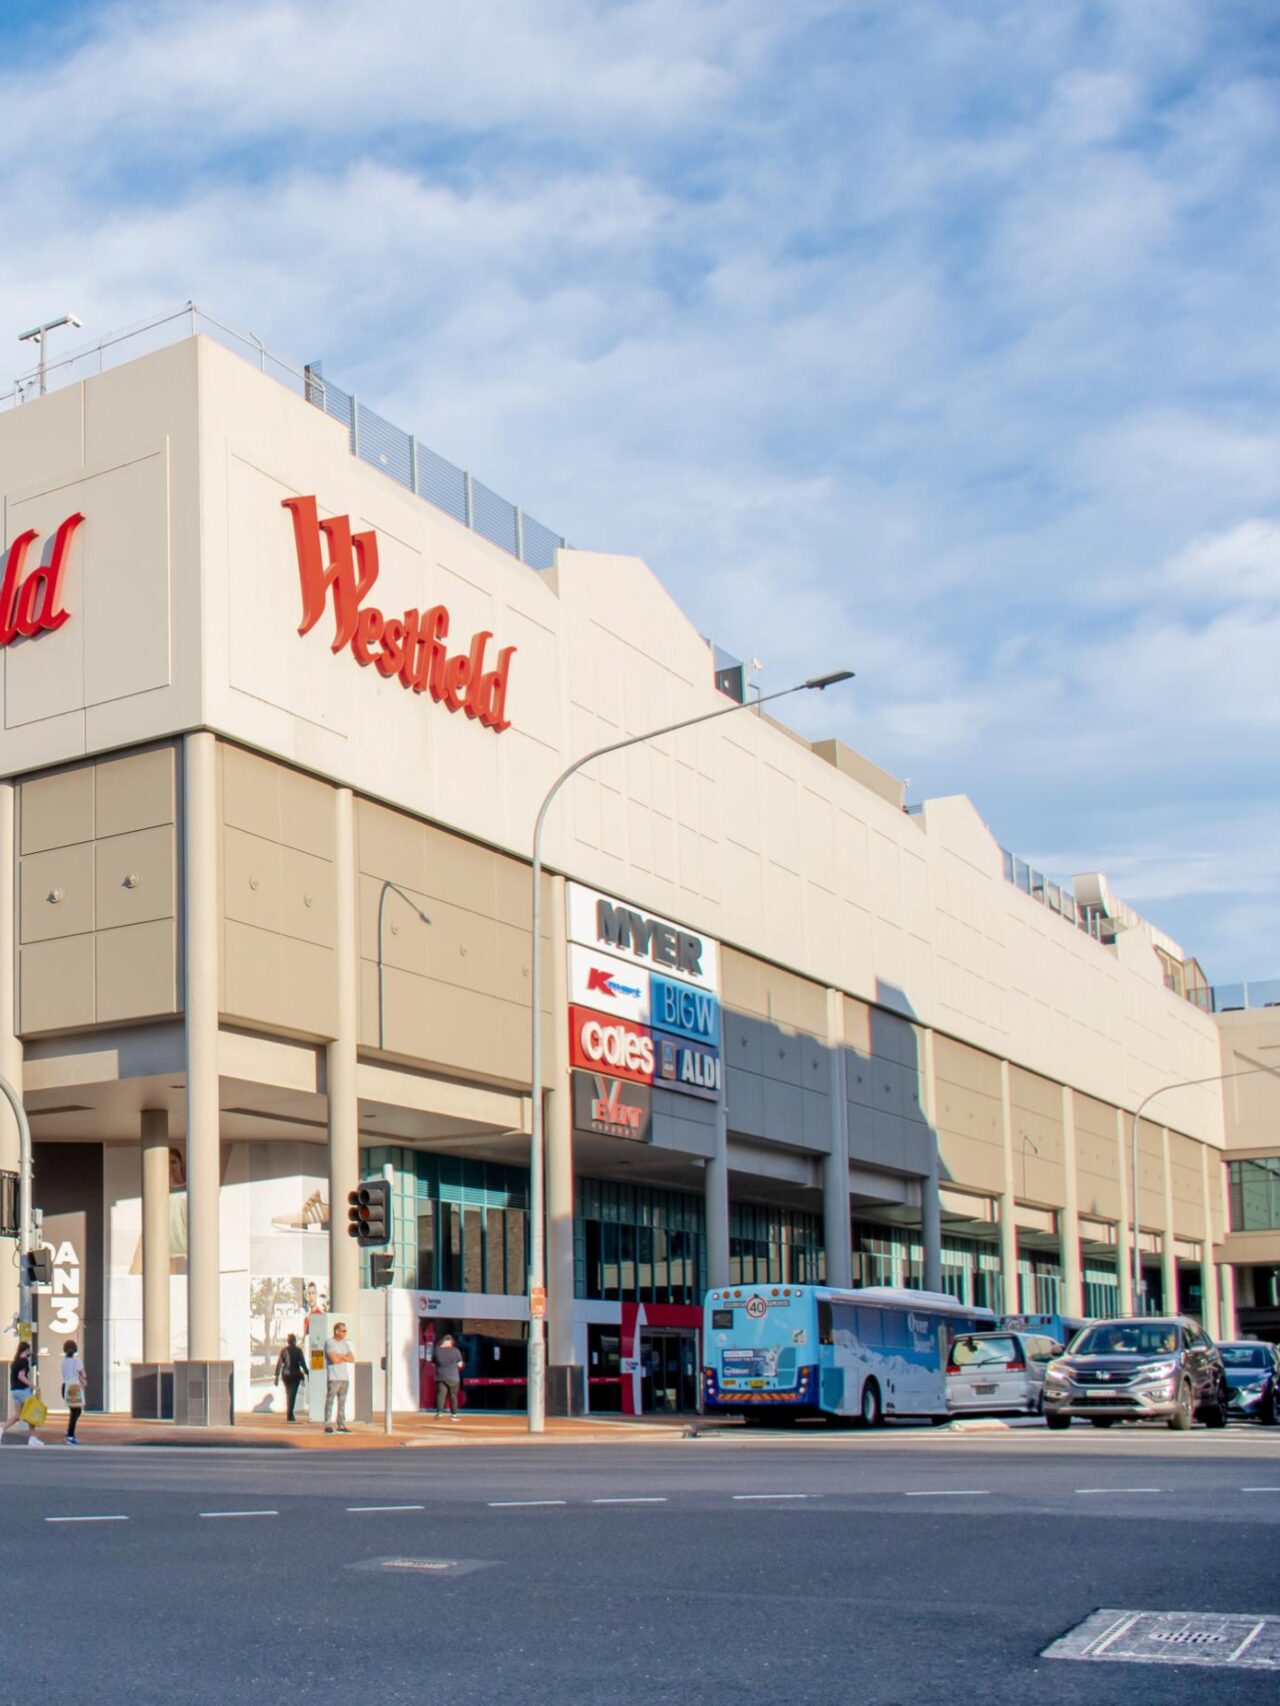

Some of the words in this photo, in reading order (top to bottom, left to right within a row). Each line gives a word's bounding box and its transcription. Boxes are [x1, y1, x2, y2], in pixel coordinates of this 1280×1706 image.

[281, 495, 517, 734] Westfield
[596, 899, 704, 977] MYER
[681, 1048, 720, 1090] ALDI
[592, 1074, 642, 1128] EVENT
[49, 1297, 80, 1334] 3
[749, 1301, 765, 1313] 40
